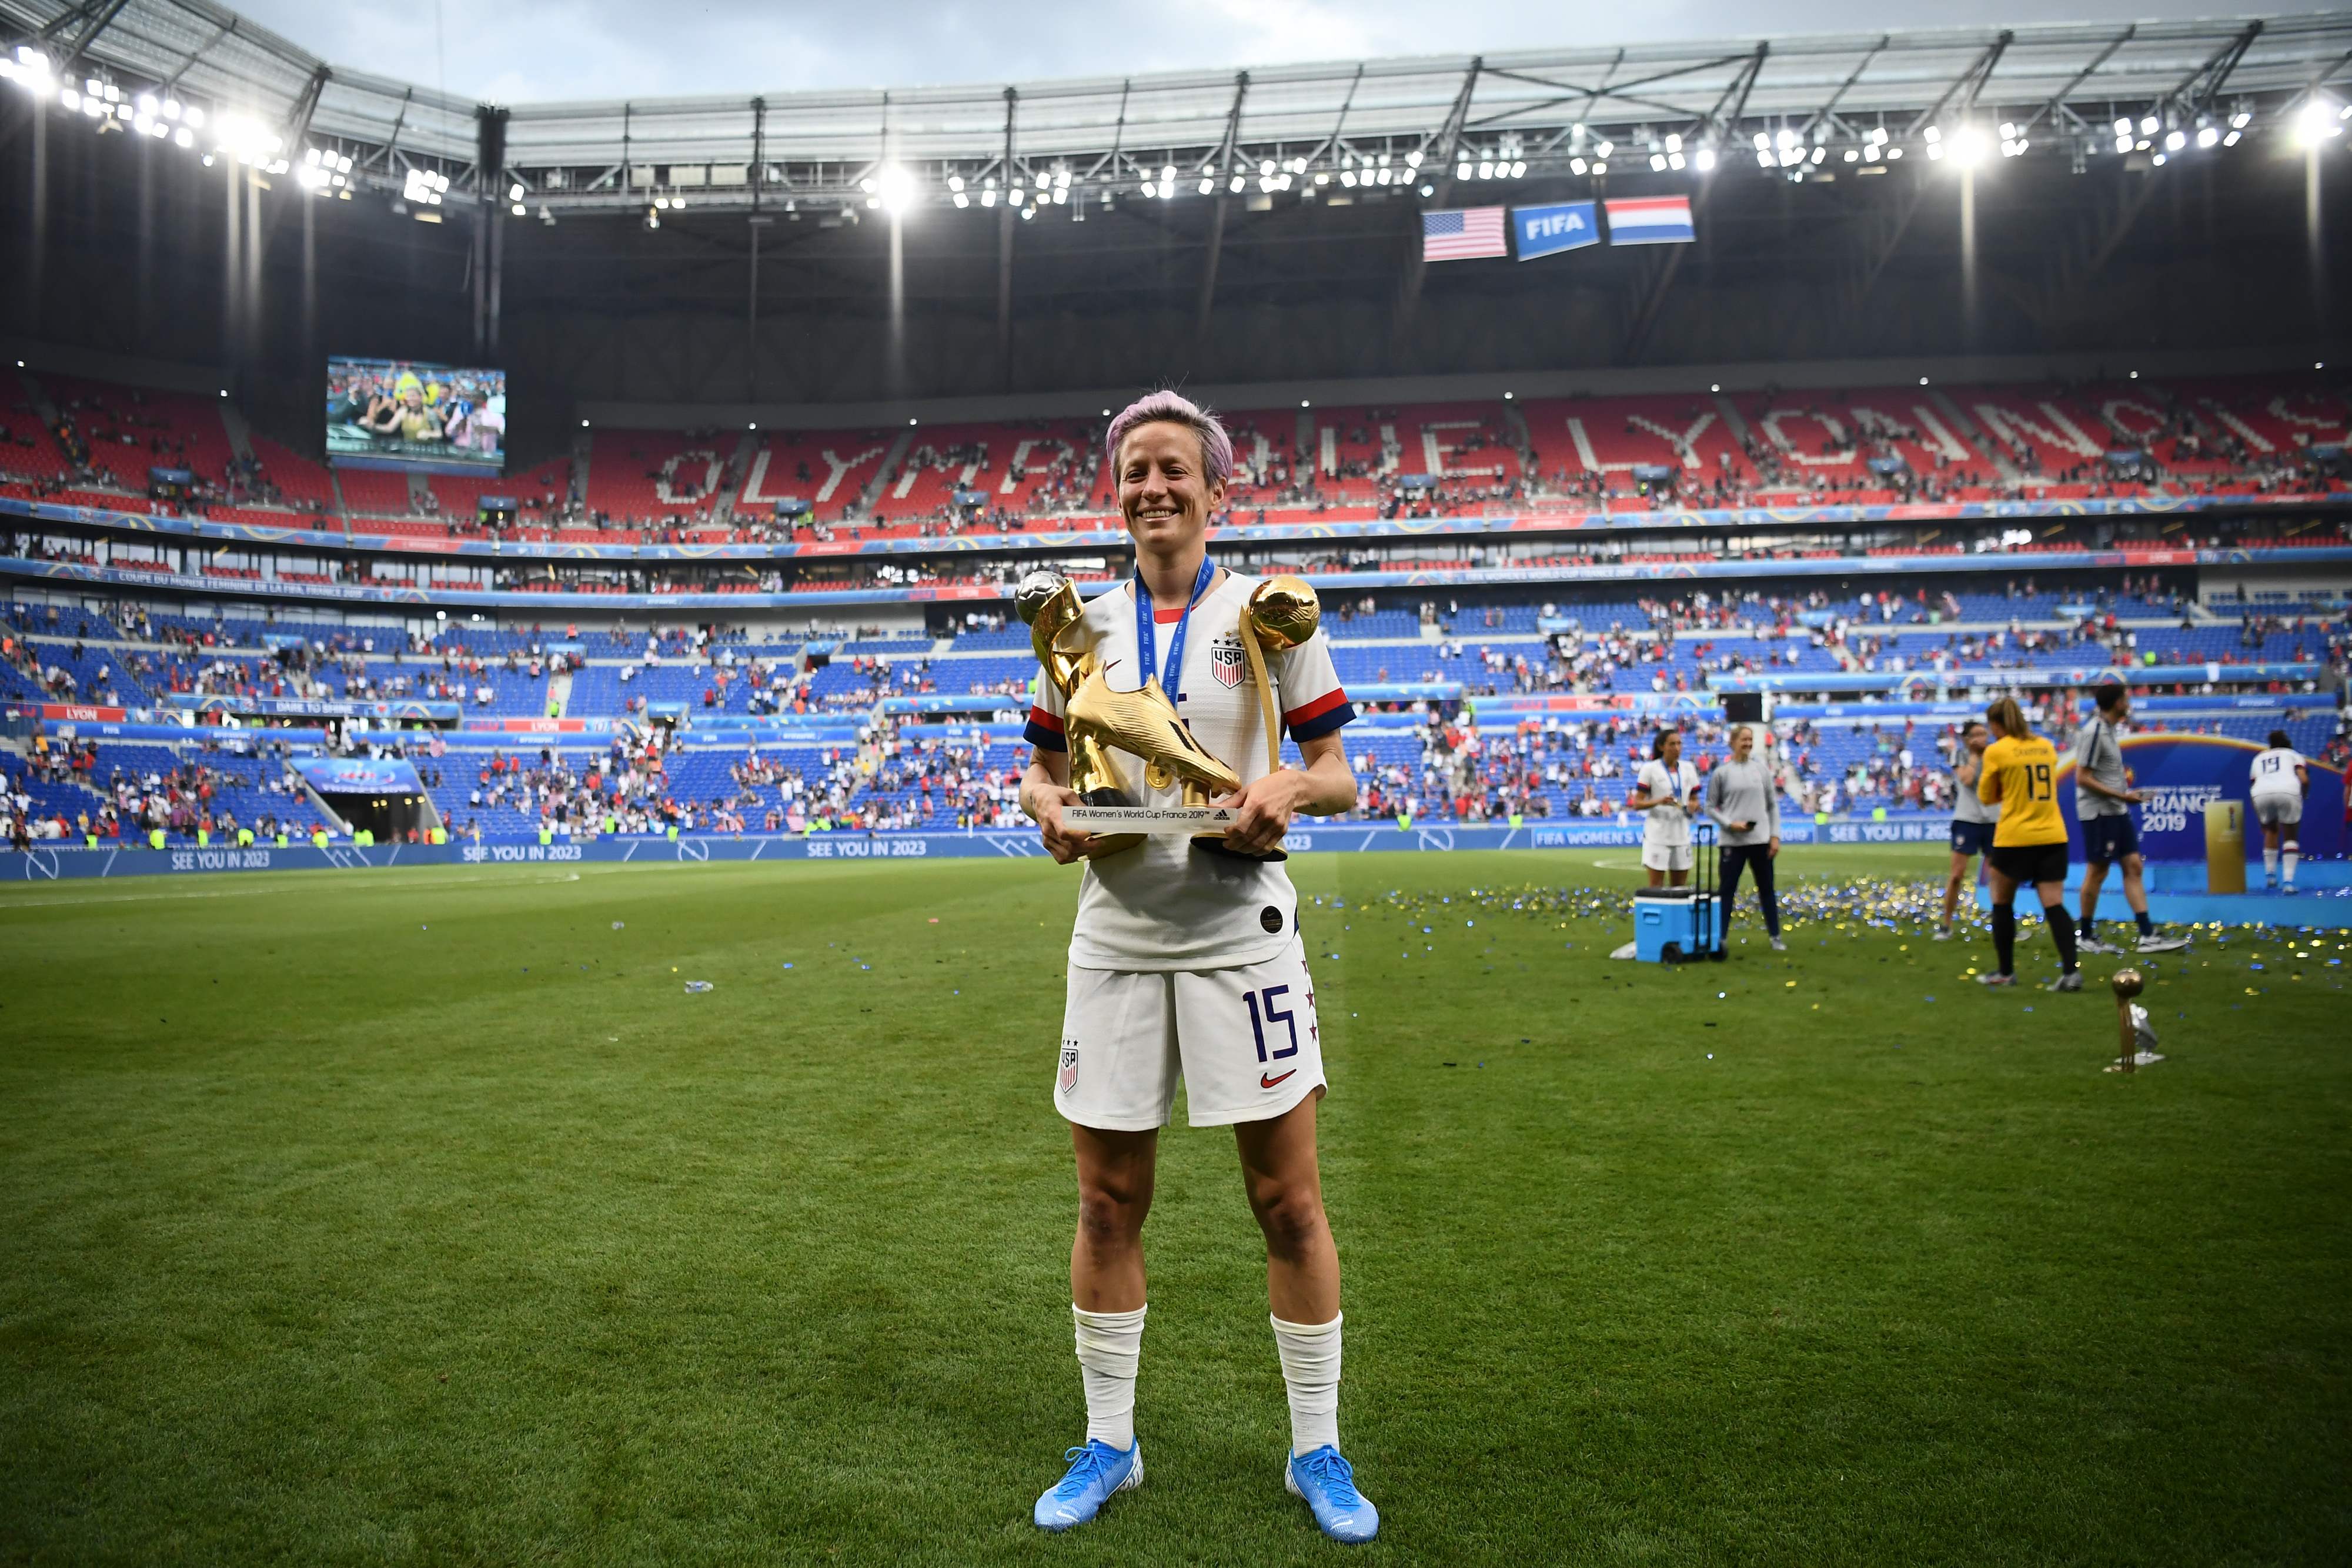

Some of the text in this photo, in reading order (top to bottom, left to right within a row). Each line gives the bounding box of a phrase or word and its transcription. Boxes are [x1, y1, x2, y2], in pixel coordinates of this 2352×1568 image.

[1526, 212, 1585, 240] FIFA
[118, 571, 151, 584] COUPE
[153, 574, 169, 584] DU
[170, 576, 206, 589] MONDE
[255, 583, 268, 592] DE
[269, 583, 282, 593] LA
[1214, 650, 1242, 665] USA
[66, 707, 98, 721] LYON
[308, 703, 322, 713] TO
[531, 721, 559, 732] LYON
[2263, 756, 2280, 774] 19
[2026, 765, 2050, 801] 19
[1072, 810, 1087, 818] FIFA
[1089, 810, 1121, 818] Women's
[1124, 810, 1144, 818] World
[1146, 811, 1161, 820] Cup
[1162, 811, 1187, 819] France
[2142, 812, 2187, 832] 2019
[1536, 832, 1565, 845] FIFA
[1566, 831, 1635, 845] WOMEN'S
[1829, 823, 1951, 842] SEE YOU IN 202
[807, 840, 927, 857] SEE YOU IN 2023
[1282, 834, 1312, 851] 023
[172, 850, 270, 870] SEE YOU IN 2023
[462, 844, 582, 862] SEE YOU IN 2023
[1242, 984, 1298, 1063] 15
[1061, 1051, 1075, 1068] USA
